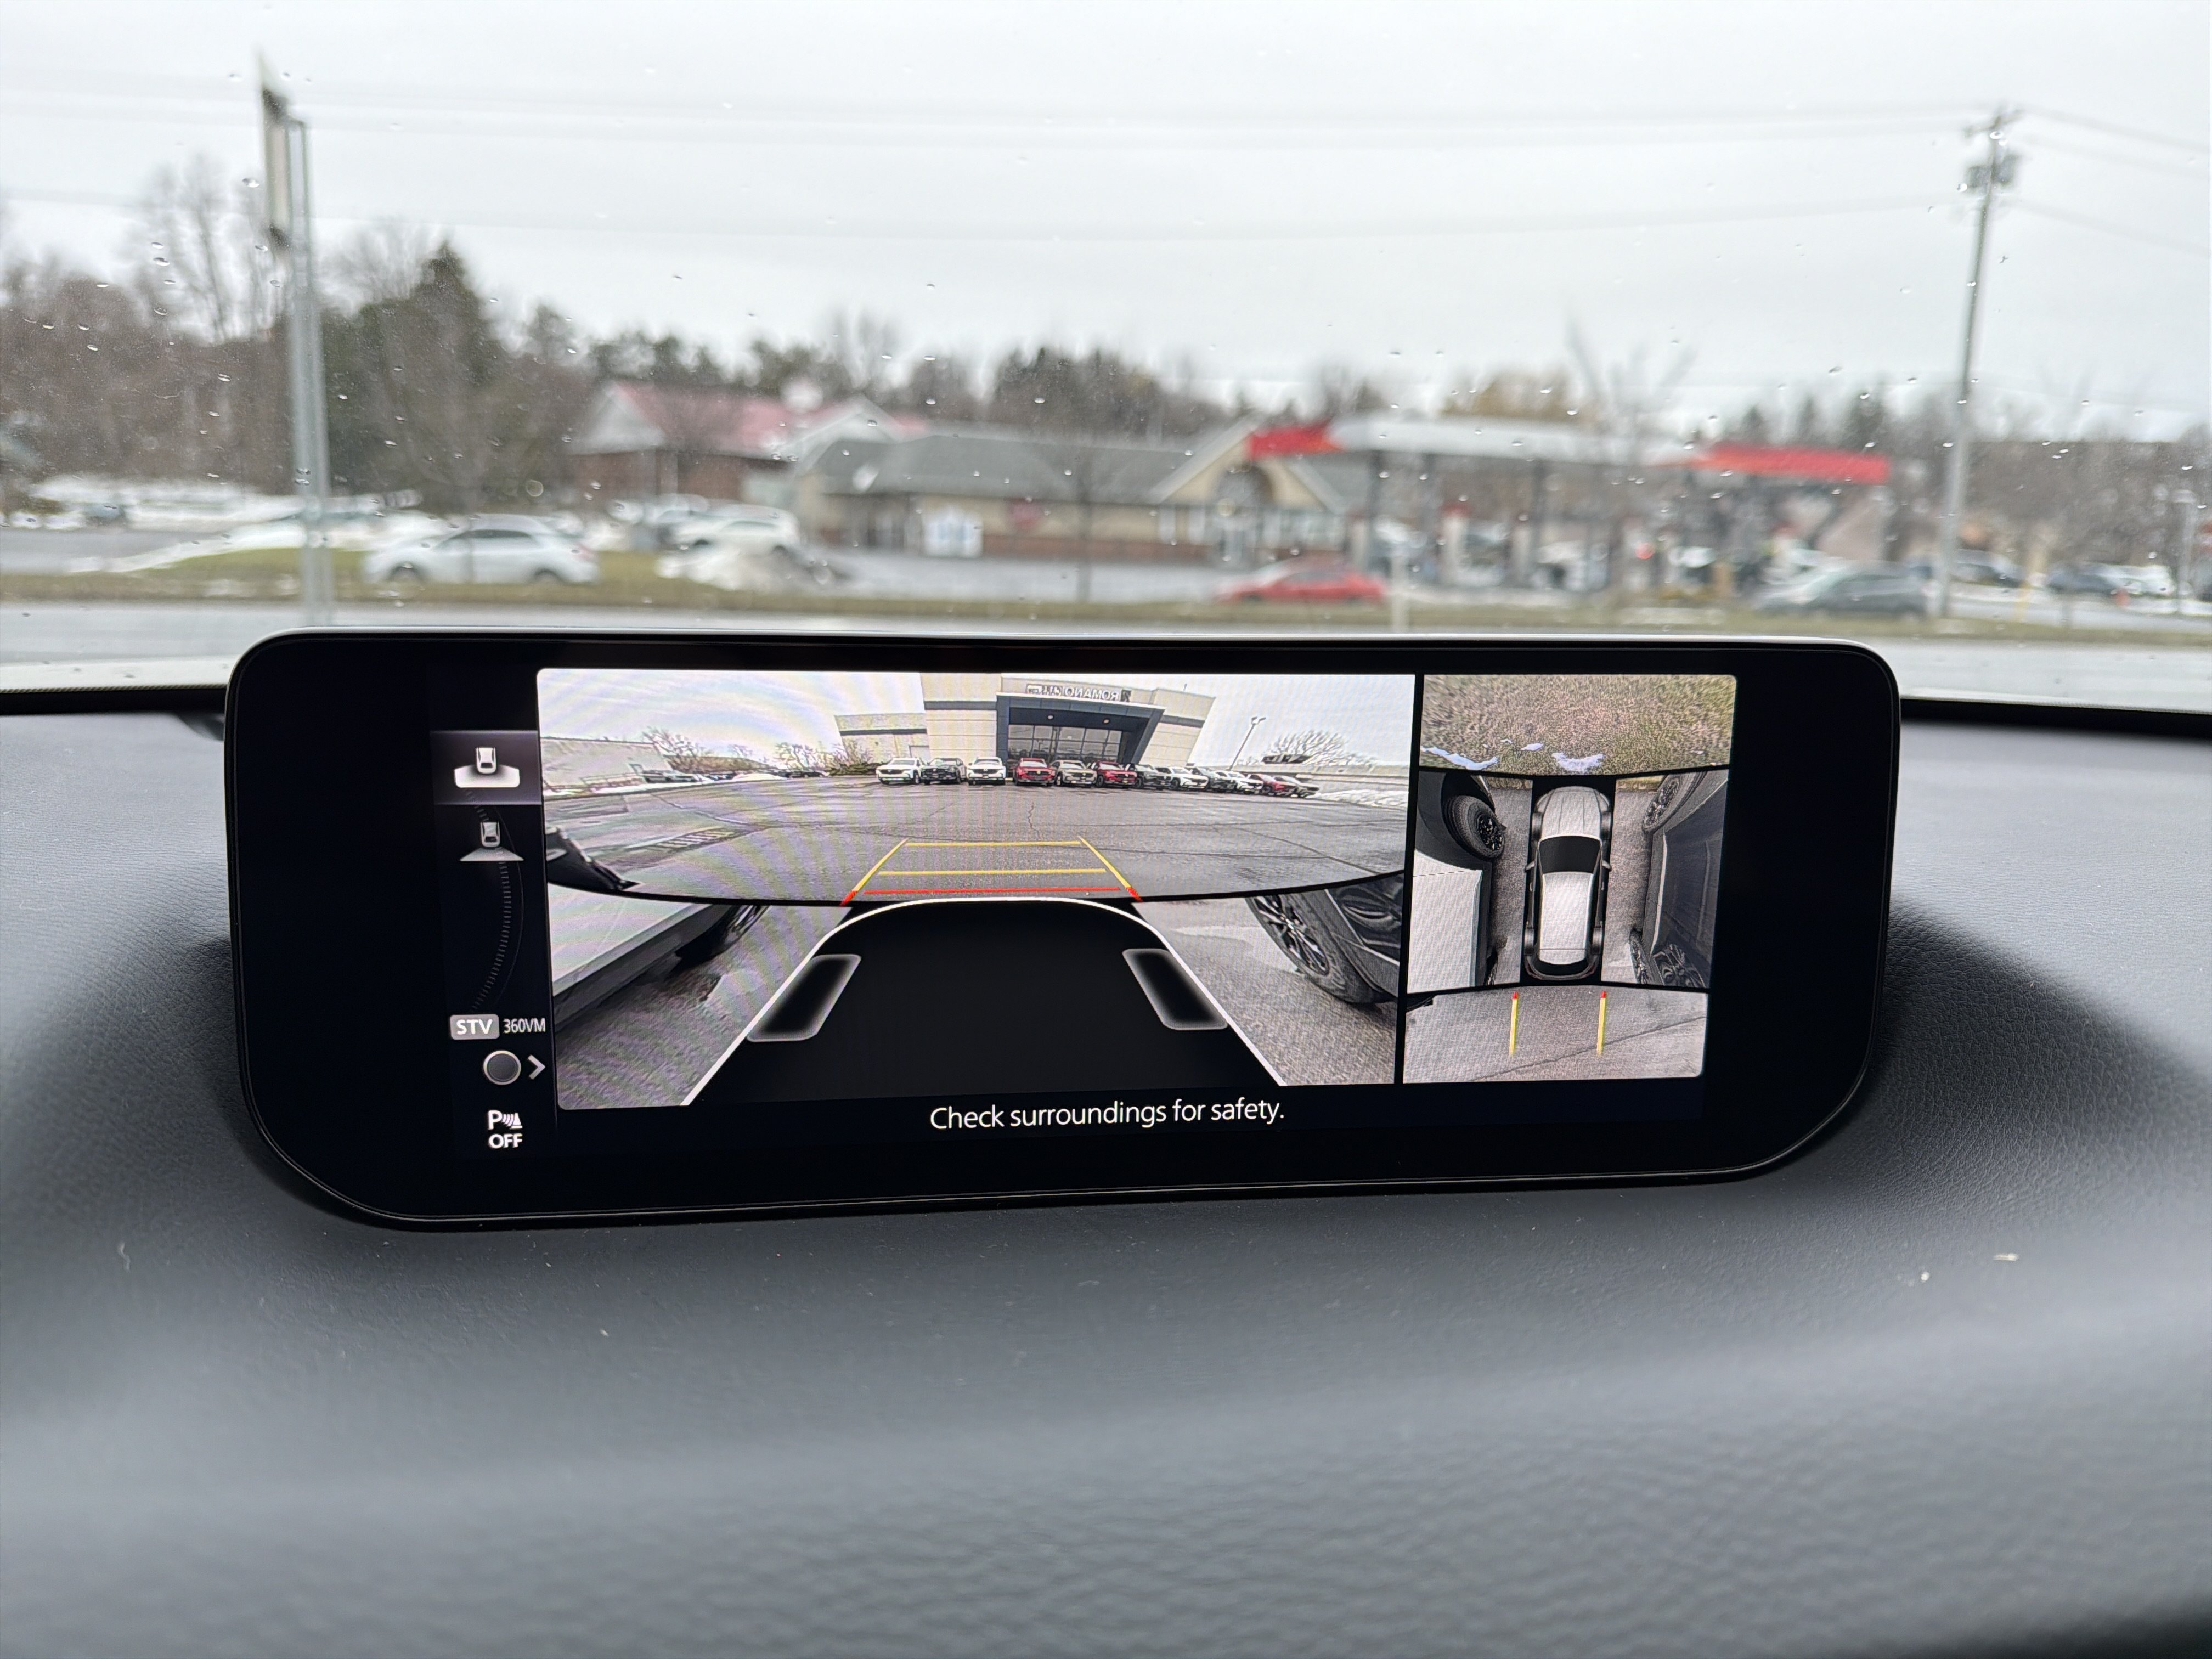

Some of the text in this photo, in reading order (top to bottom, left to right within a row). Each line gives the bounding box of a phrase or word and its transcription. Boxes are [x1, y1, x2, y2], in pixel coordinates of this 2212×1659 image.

[456, 1019, 493, 1035] STV
[503, 1018, 546, 1034] 360VM
[930, 1097, 1284, 1130] Check surroundings for safety.
[488, 1133, 523, 1148] OFF
